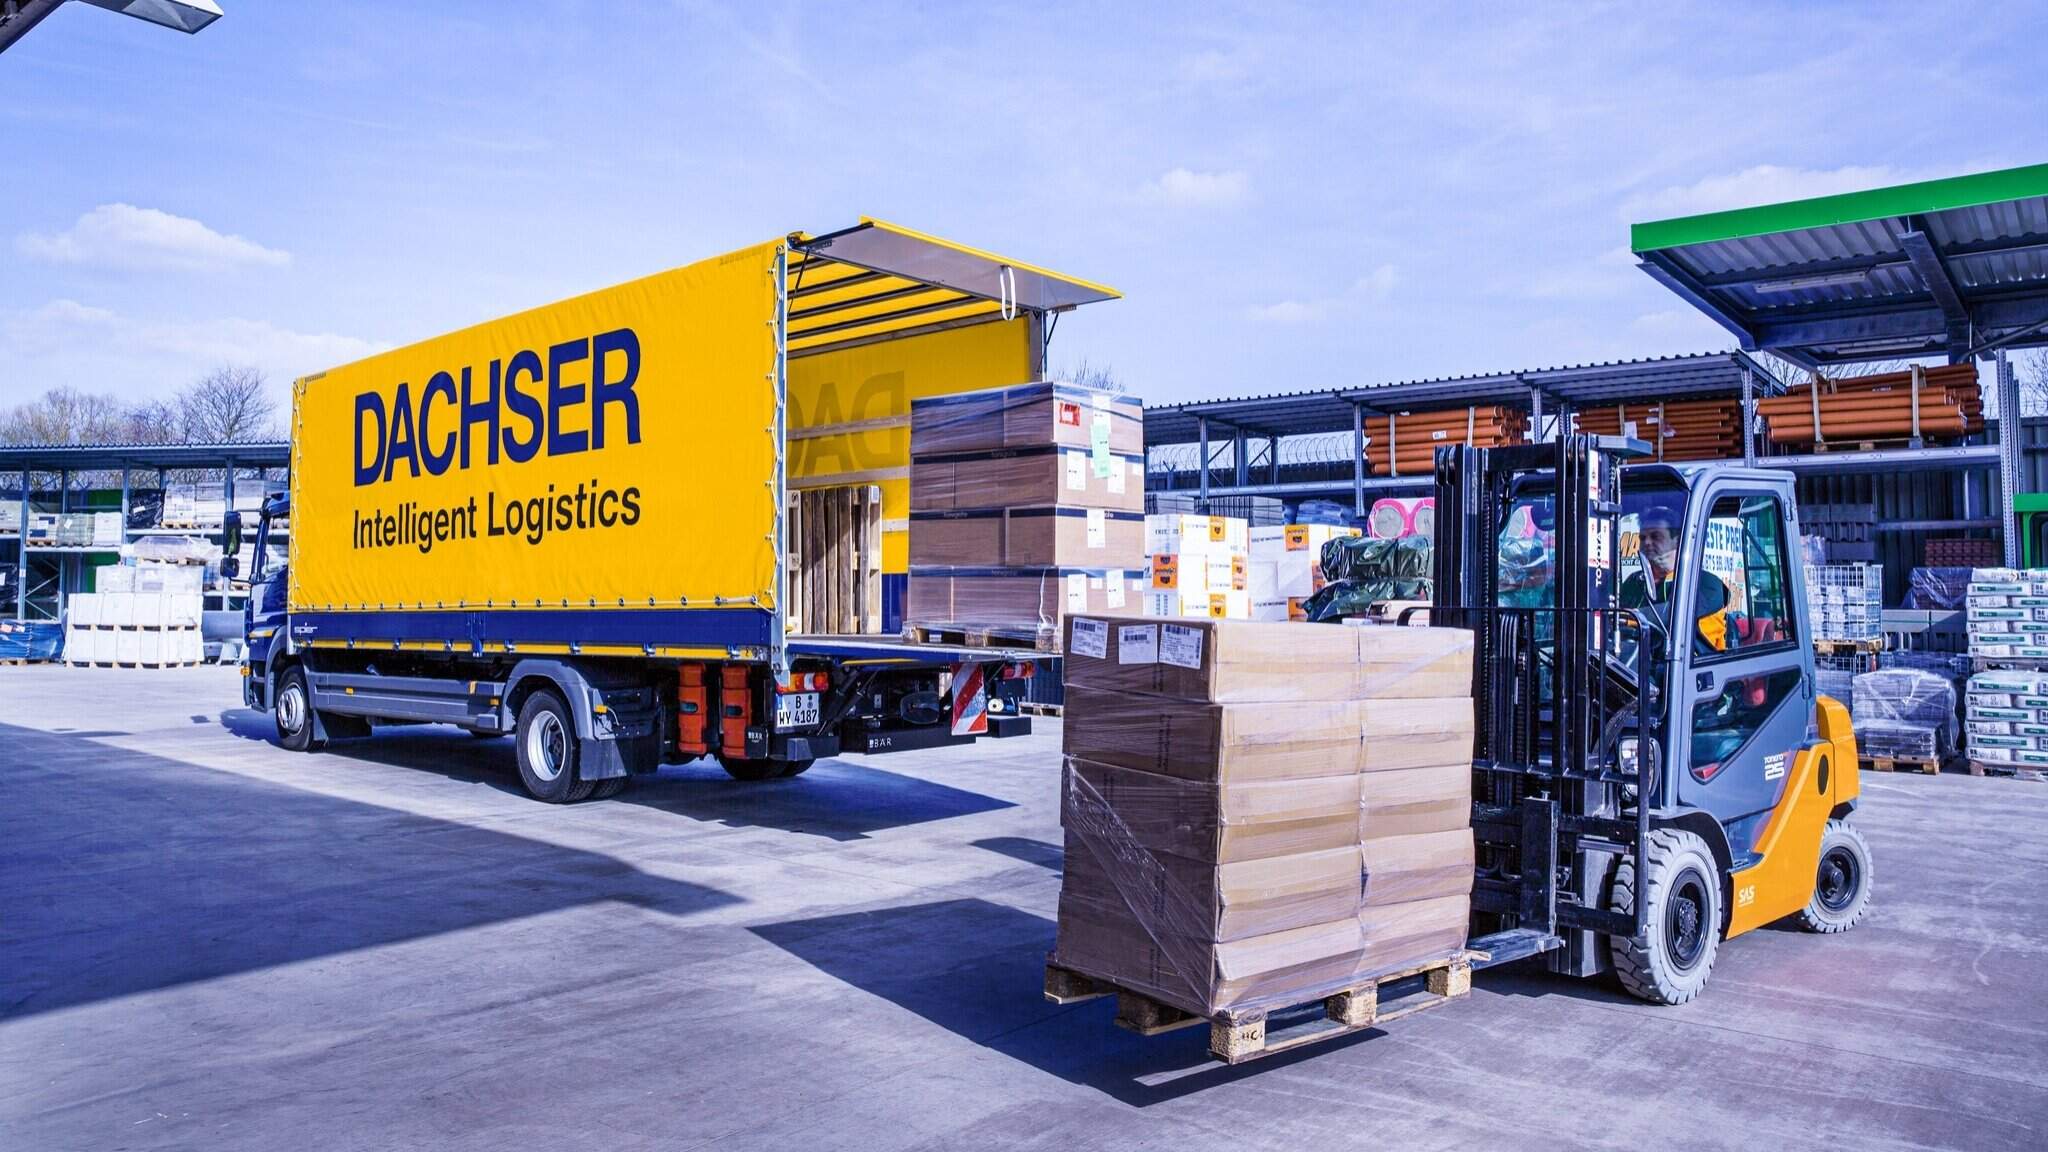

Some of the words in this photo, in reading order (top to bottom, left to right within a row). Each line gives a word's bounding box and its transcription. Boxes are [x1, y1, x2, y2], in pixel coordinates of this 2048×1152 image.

[354, 327, 641, 487] DACHSER
[353, 502, 477, 554] Intelligent
[487, 479, 641, 545] Logistics
[795, 695, 802, 709] B
[794, 709, 818, 724] 4187
[1764, 761, 1785, 781] 25
[1738, 885, 1755, 903] SAS
